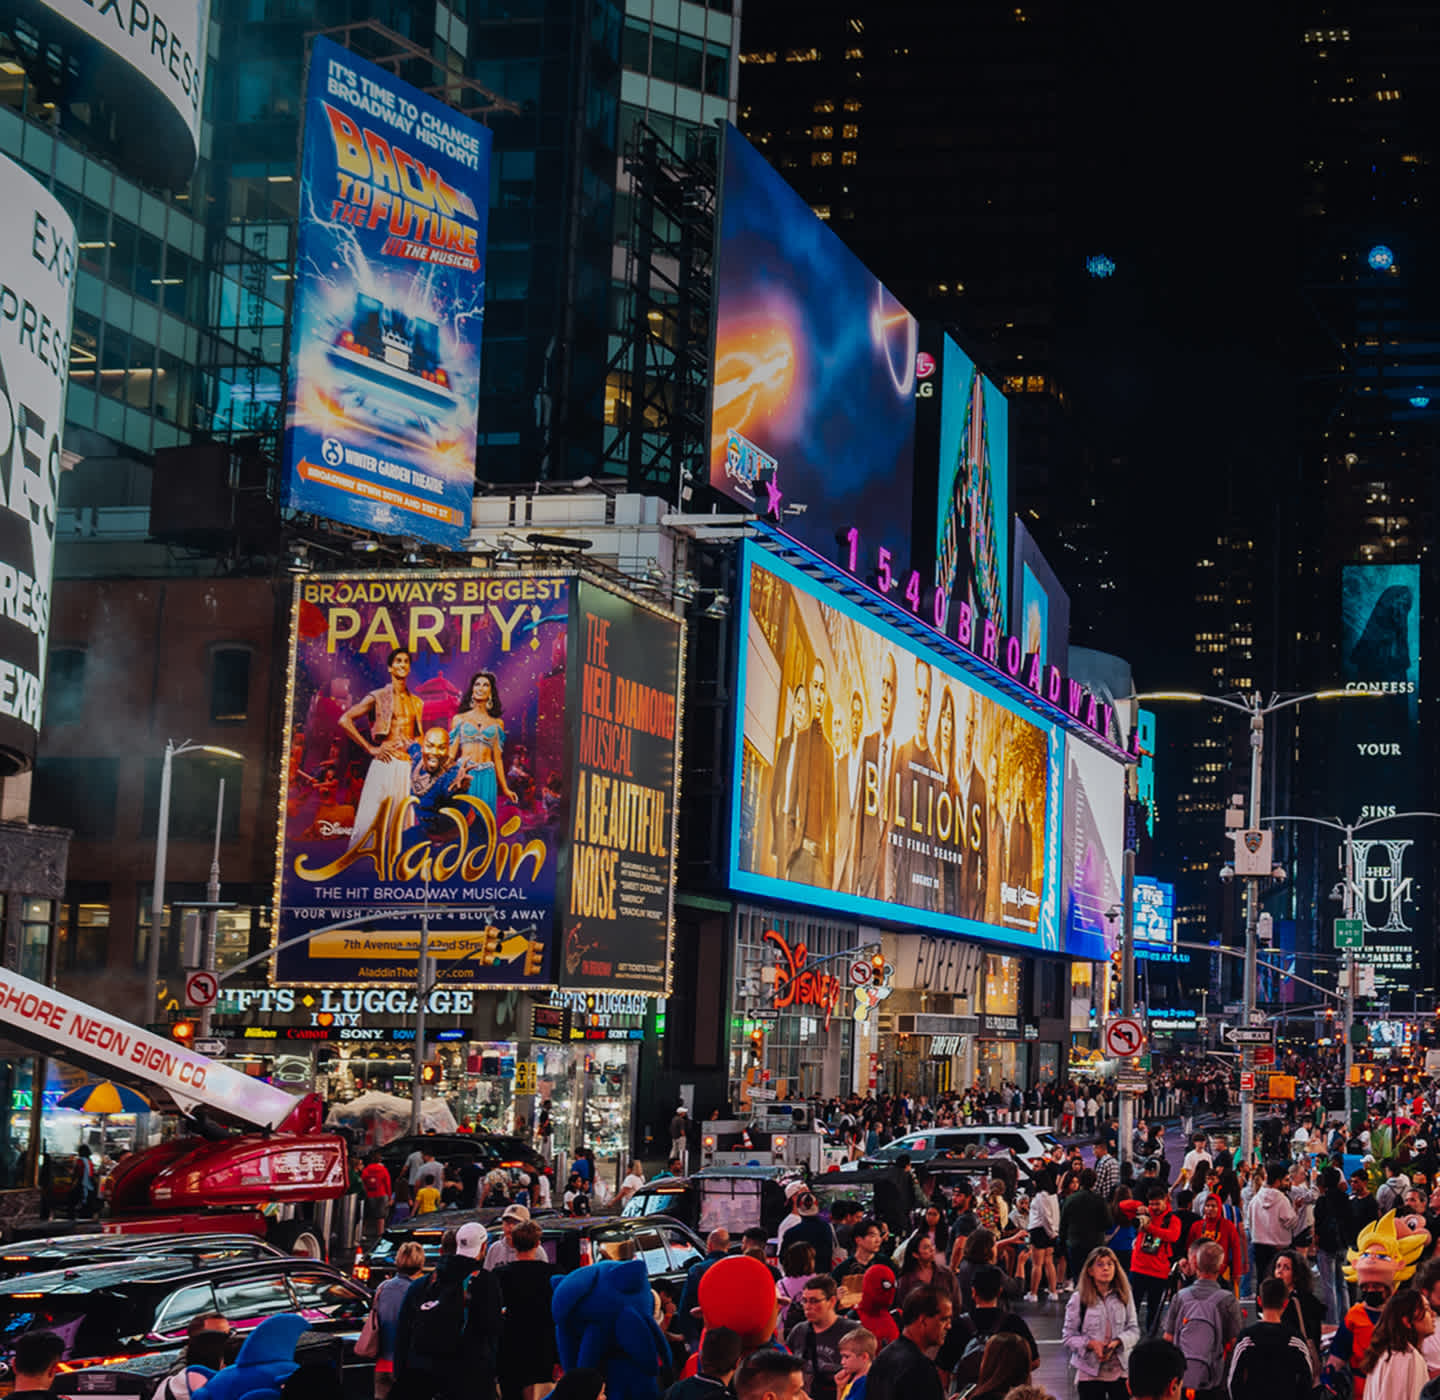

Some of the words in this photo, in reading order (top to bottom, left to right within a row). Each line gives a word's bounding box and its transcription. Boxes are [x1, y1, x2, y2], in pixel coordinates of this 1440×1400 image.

[82, 0, 200, 113] XPRESS
[327, 76, 413, 135] BROADWAY
[416, 124, 479, 172] HISTORY!
[328, 58, 357, 89] IT'S
[360, 75, 396, 110] TIME
[399, 97, 418, 120] TO
[421, 111, 480, 155] CHANGE
[320, 98, 479, 221] BACK
[336, 171, 371, 208] TO
[330, 199, 368, 228] THE
[366, 188, 479, 256] FUTURE
[404, 243, 428, 262] THE
[429, 249, 475, 270] MUSICAL
[345, 447, 377, 473] WINTER
[378, 459, 411, 484] GARDEN
[304, 582, 458, 605] BROADWAY'S
[463, 578, 566, 601] BIGGEST
[326, 603, 543, 654] PARTY!
[584, 612, 612, 670] THE
[582, 663, 612, 720] NEIL
[614, 676, 675, 741] DIAMOND
[1345, 681, 1416, 695] CONFESS
[578, 713, 634, 778] MUSICAL
[1357, 743, 1402, 757] YOUR
[575, 770, 587, 834] A
[589, 774, 669, 859] BEAUTIFUL
[864, 760, 983, 853] BILLIONS
[1361, 804, 1398, 819] SINS
[293, 794, 547, 883] Aladdin
[888, 831, 903, 848] THE
[907, 838, 931, 857] FINAL
[933, 845, 963, 866] SEASON
[314, 886, 342, 900] THE
[346, 886, 370, 900] HIT
[374, 886, 459, 900] BROADWAY
[462, 886, 528, 900] MUSICAL
[570, 843, 620, 920] NOISE
[293, 909, 326, 920] YOUR
[331, 908, 361, 920] WISH
[511, 909, 546, 920] AWAY
[343, 938, 360, 951] 7th
[1375, 945, 1413, 953] THEATERS
[763, 929, 841, 1032] Disney
[217, 988, 296, 1013] IFTS
[319, 990, 474, 1015] LUGGAGE
[332, 1012, 362, 1027] NY
[594, 991, 649, 1016] LUGGAGE
[0, 982, 67, 1030] SHORE
[68, 1013, 131, 1057] NEON
[130, 1041, 179, 1077] SIGN
[178, 1061, 208, 1091] CO.
[286, 1027, 329, 1039] Canon
[339, 1028, 384, 1040] SONY
[1251, 1031, 1267, 1039] WAY
[517, 1062, 528, 1091] ATM
